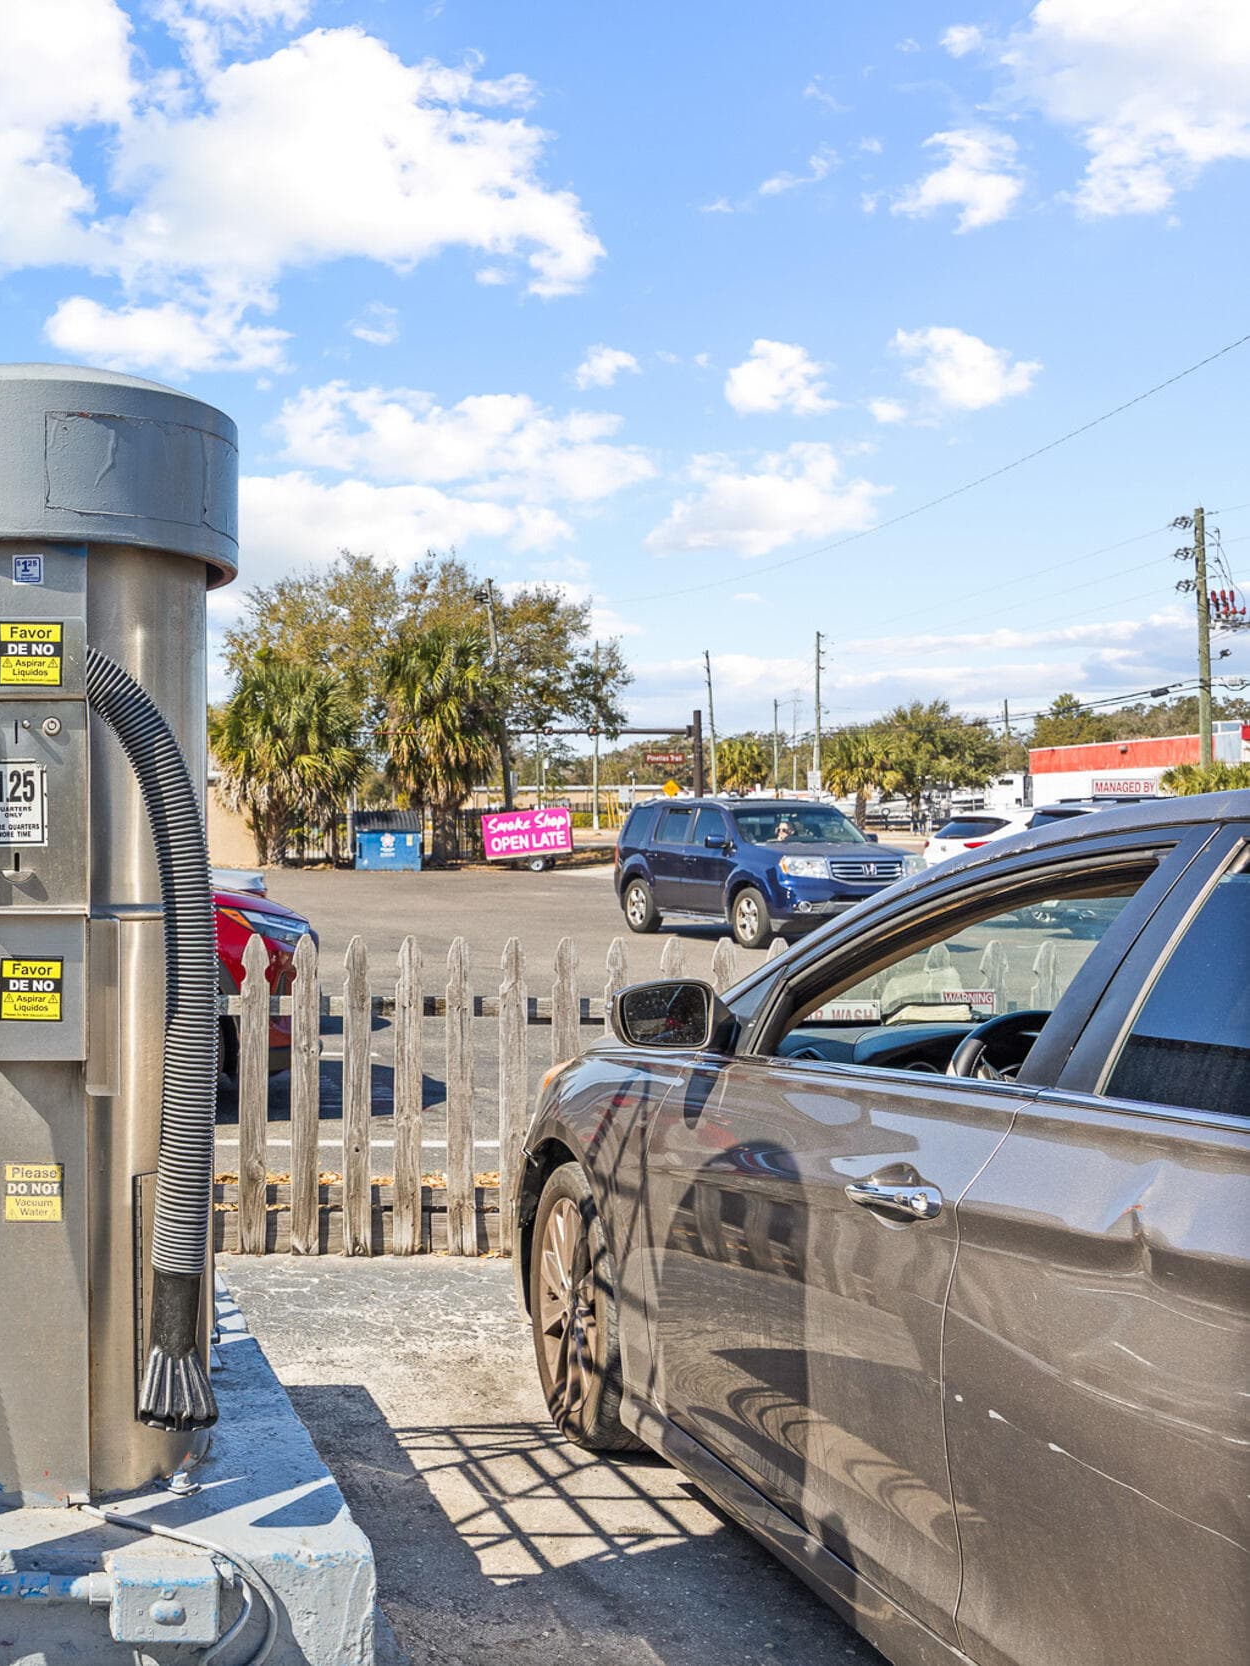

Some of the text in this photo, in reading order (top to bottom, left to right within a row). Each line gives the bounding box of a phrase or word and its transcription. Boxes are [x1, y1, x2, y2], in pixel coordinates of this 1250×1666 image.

[10, 626, 52, 639] Favor
[7, 643, 55, 656] DE NO
[15, 660, 46, 669] Aspirar
[1095, 782, 1155, 793] MANAGED BY
[487, 811, 567, 835] Smoke Shop
[491, 830, 567, 852] OPEN LATE
[12, 963, 53, 976] Favor
[9, 979, 55, 992] DE NO
[16, 995, 47, 1004] Aspirar
[943, 992, 994, 1004] WARNING
[831, 1008, 874, 1021] WASH
[11, 1166, 57, 1179] Please
[7, 1182, 60, 1195] DO NOT
[14, 1198, 54, 1207] Vacuum
[19, 1207, 48, 1217] Water
